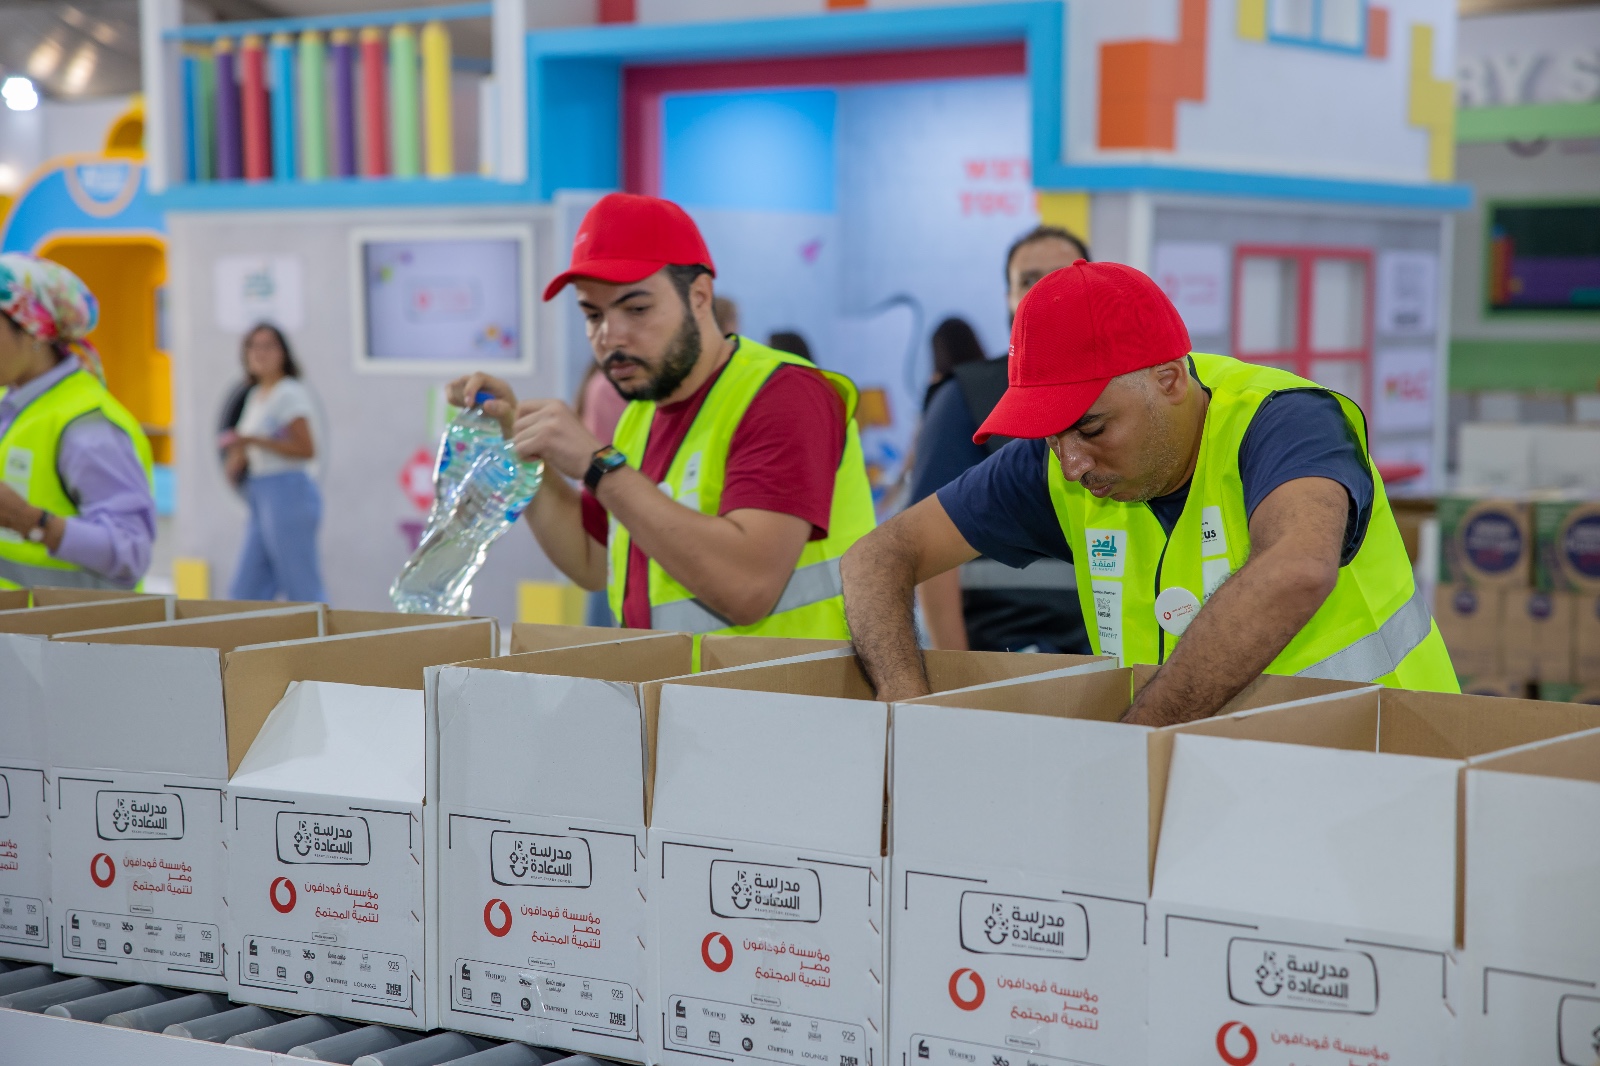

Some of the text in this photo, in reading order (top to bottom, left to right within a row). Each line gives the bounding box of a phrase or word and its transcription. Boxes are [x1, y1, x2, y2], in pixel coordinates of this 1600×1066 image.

[1201, 529, 1217, 540] us
[131, 800, 167, 817] مدرسة
[132, 815, 167, 829] السعادة
[314, 822, 352, 840] مدرسة
[314, 838, 352, 854] السعادة
[530, 843, 572, 862] مدرسة
[159, 859, 191, 872] مؤسسة
[531, 859, 572, 877] السعادة
[133, 881, 192, 895] لتنمية المجتمع
[754, 873, 800, 893] مدرسة
[344, 885, 378, 899] مؤسسة
[755, 890, 800, 910] السعادة
[26, 904, 37, 913] 925
[315, 906, 378, 923] لتنمية المجتمع
[562, 909, 600, 924] مؤسسة
[1012, 906, 1064, 928] مدرسة
[201, 930, 212, 939] 925
[573, 925, 600, 935] مصر
[1012, 925, 1064, 946] السعادة
[532, 930, 601, 949] لتنمية المجتمع
[302, 949, 316, 960] 360
[789, 944, 830, 961] مؤسسة
[388, 960, 400, 971] 925
[800, 961, 830, 973] مصر
[1287, 954, 1349, 980] مدرسة
[755, 966, 830, 988] لتنمية المجتمع
[354, 982, 376, 990] LOUNGE
[386, 983, 398, 992] THE
[1051, 982, 1099, 1002] مؤسسة
[1288, 975, 1349, 1000] السعادة
[611, 989, 624, 999] 925
[574, 1010, 599, 1018] LOUNGE
[610, 1012, 623, 1021] THE
[740, 1013, 755, 1025] 360
[1011, 1005, 1099, 1030] لتنمية المجتمع
[842, 1030, 856, 1041] 925
[802, 1051, 828, 1061] LOUNGE
[840, 1055, 854, 1065] THE
